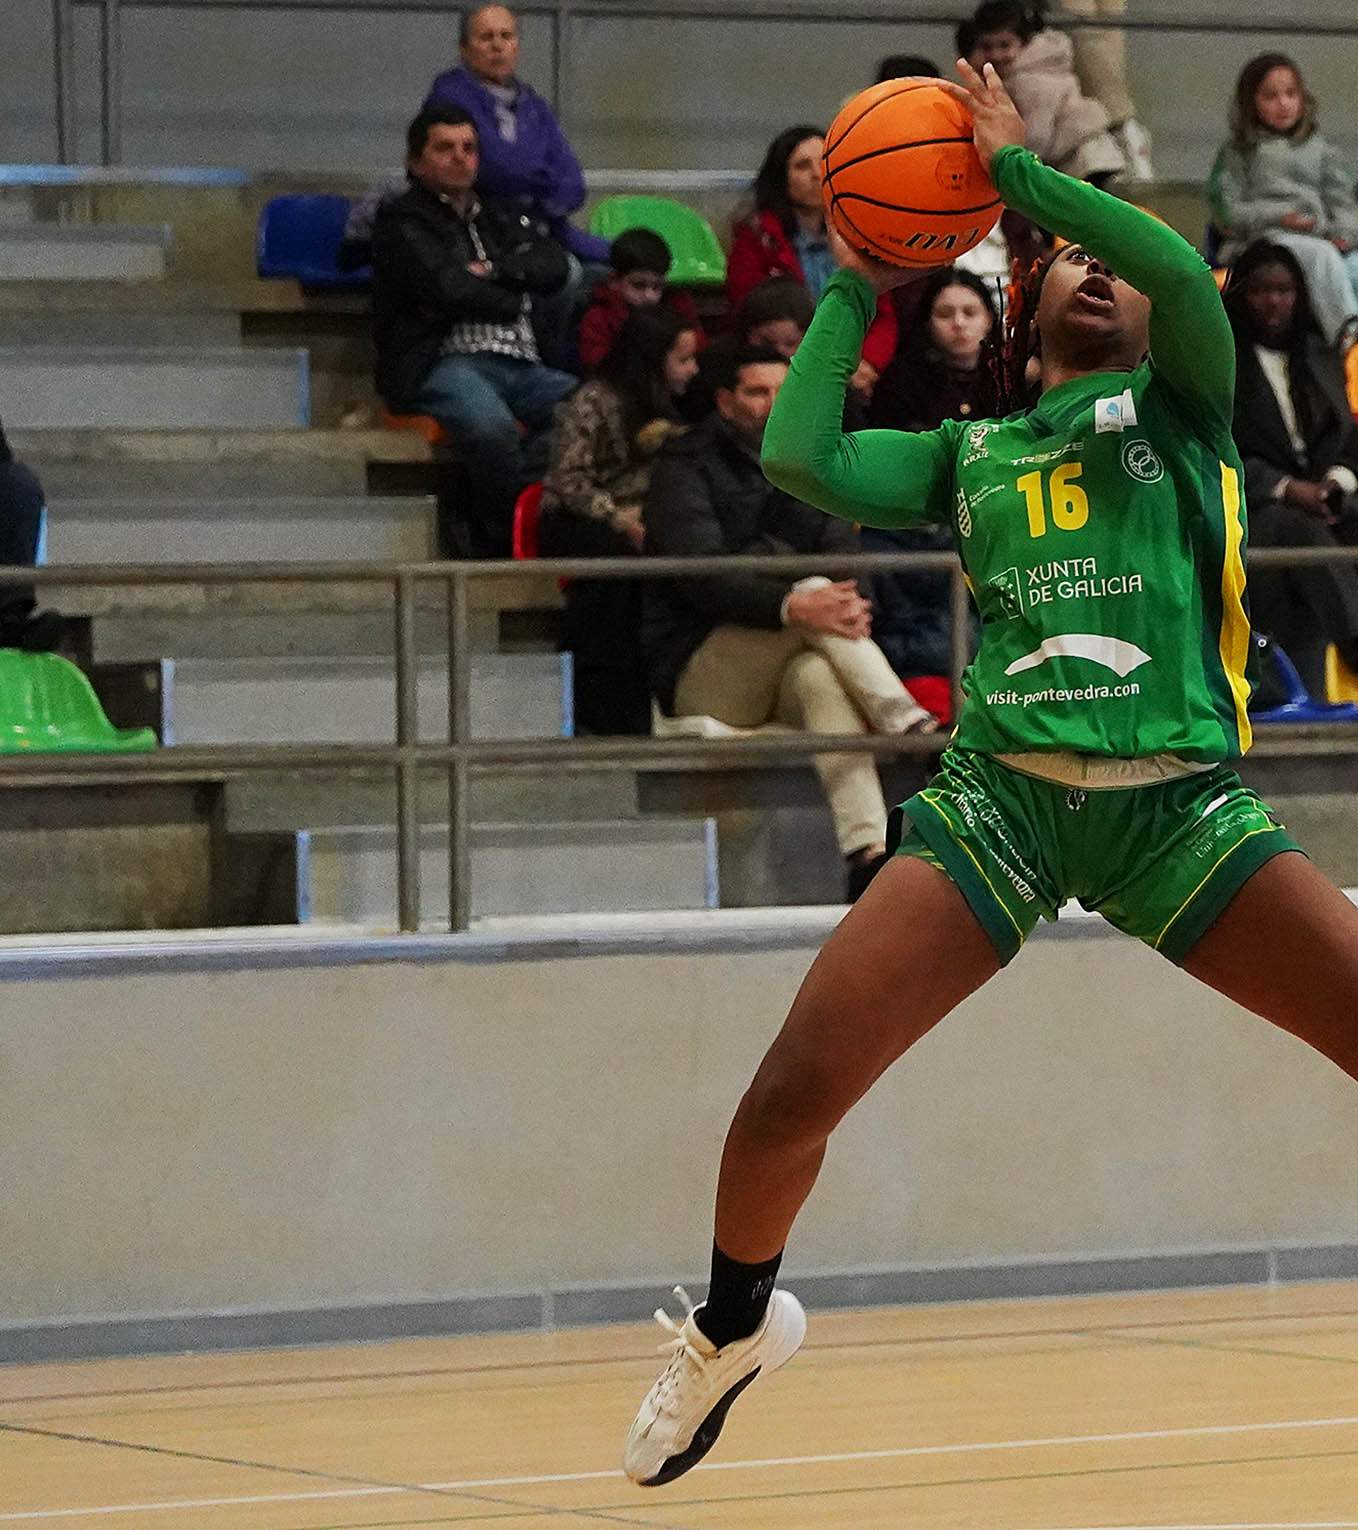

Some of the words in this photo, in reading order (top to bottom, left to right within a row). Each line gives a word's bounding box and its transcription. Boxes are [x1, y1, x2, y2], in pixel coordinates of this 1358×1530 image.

[1016, 462, 1090, 539] 16
[1026, 557, 1097, 586] XUNTA
[1029, 584, 1054, 607] DE
[1056, 574, 1143, 599] GALICIA
